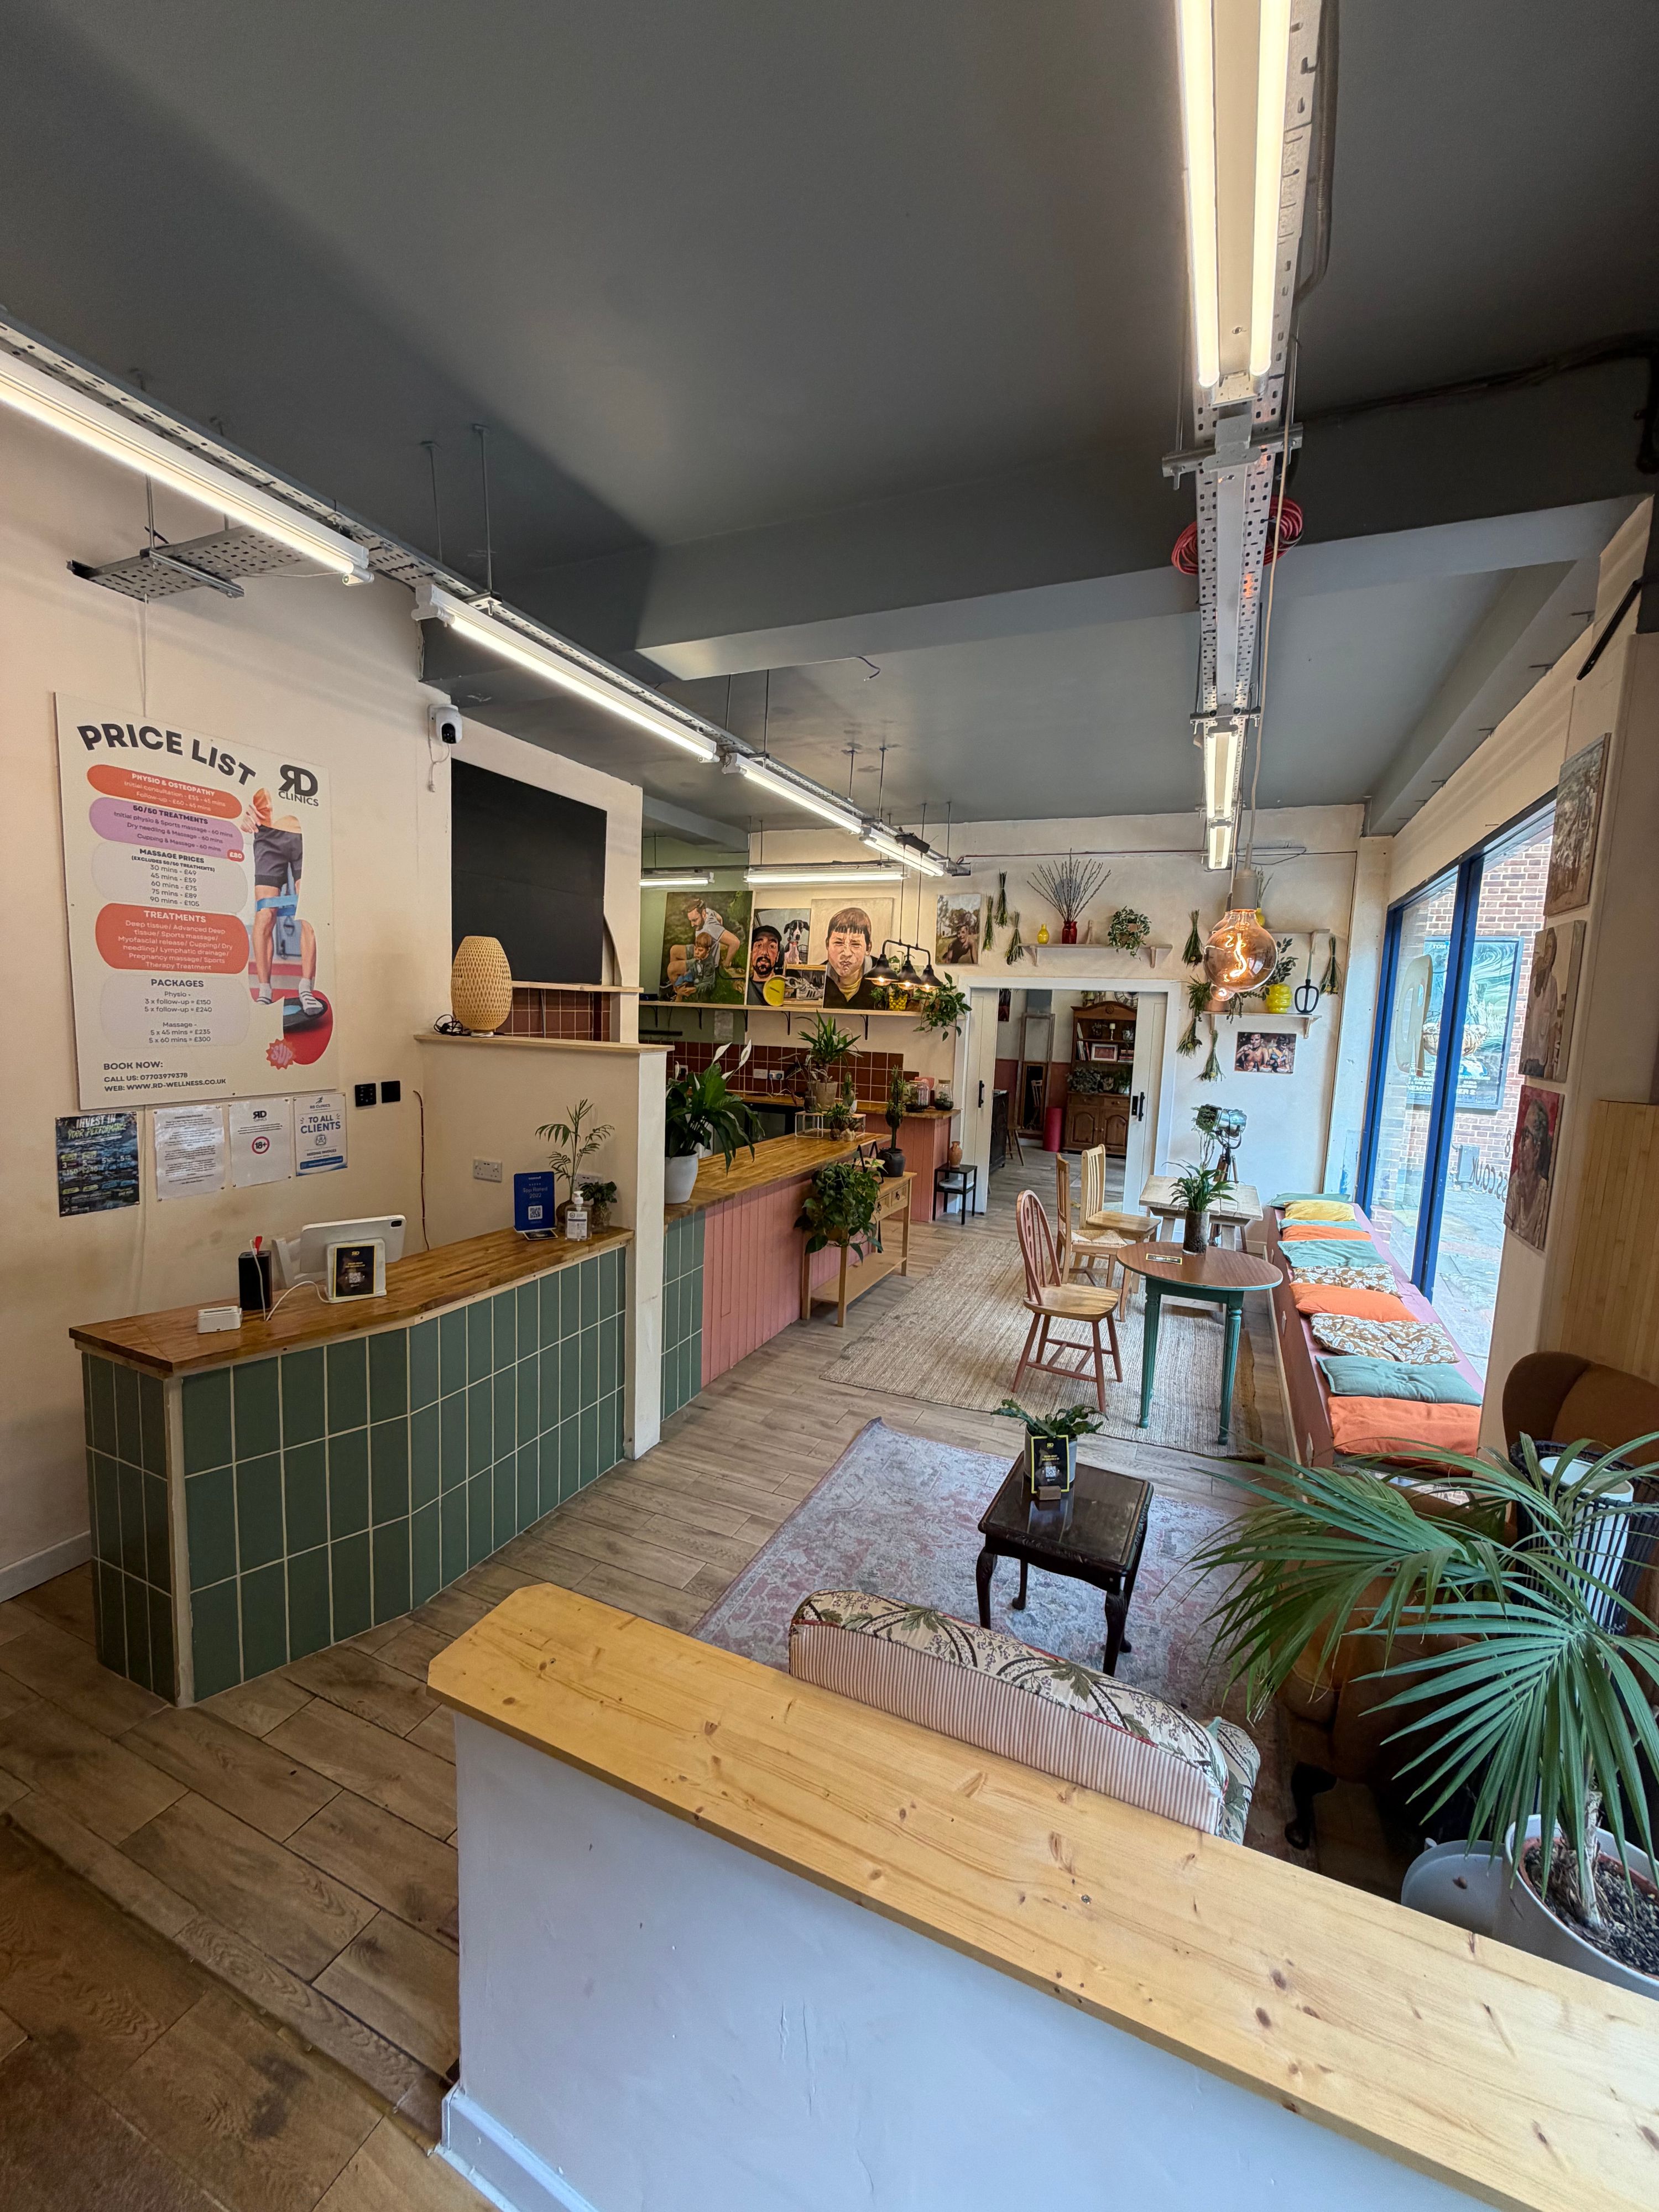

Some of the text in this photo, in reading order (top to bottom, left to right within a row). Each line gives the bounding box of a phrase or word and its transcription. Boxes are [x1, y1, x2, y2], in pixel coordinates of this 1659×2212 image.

[77, 723, 256, 785] PRICE LIST
[132, 773, 160, 784] PHYSIO
[168, 781, 215, 796] OSTEOPATHY
[137, 791, 168, 802] Follow-up
[144, 786, 182, 797] consultation
[278, 791, 319, 806] CLINICS
[133, 805, 208, 825] 50/50 TREATMENTS
[139, 825, 165, 834] needling
[172, 831, 197, 839] Massage
[181, 825, 207, 833] massage
[137, 833, 163, 843] Cupping
[170, 839, 195, 848] Massage
[139, 848, 204, 863] MASSAGE PRICES
[132, 855, 162, 864] (EXCLUDES
[180, 863, 215, 872] TREATMENTS)
[143, 910, 206, 923] TREATMENTS
[126, 920, 145, 928] Deep
[118, 936, 158, 944] Myofascial
[189, 941, 221, 950] Cupping/
[129, 953, 167, 961] Pregnancy
[151, 979, 204, 987] PACKAGES
[126, 1079, 226, 1090] WWW.RD-WELLNESS.CO.UK
[76, 1116, 107, 1129] INVEST
[301, 1121, 341, 1134] CLIENTS
